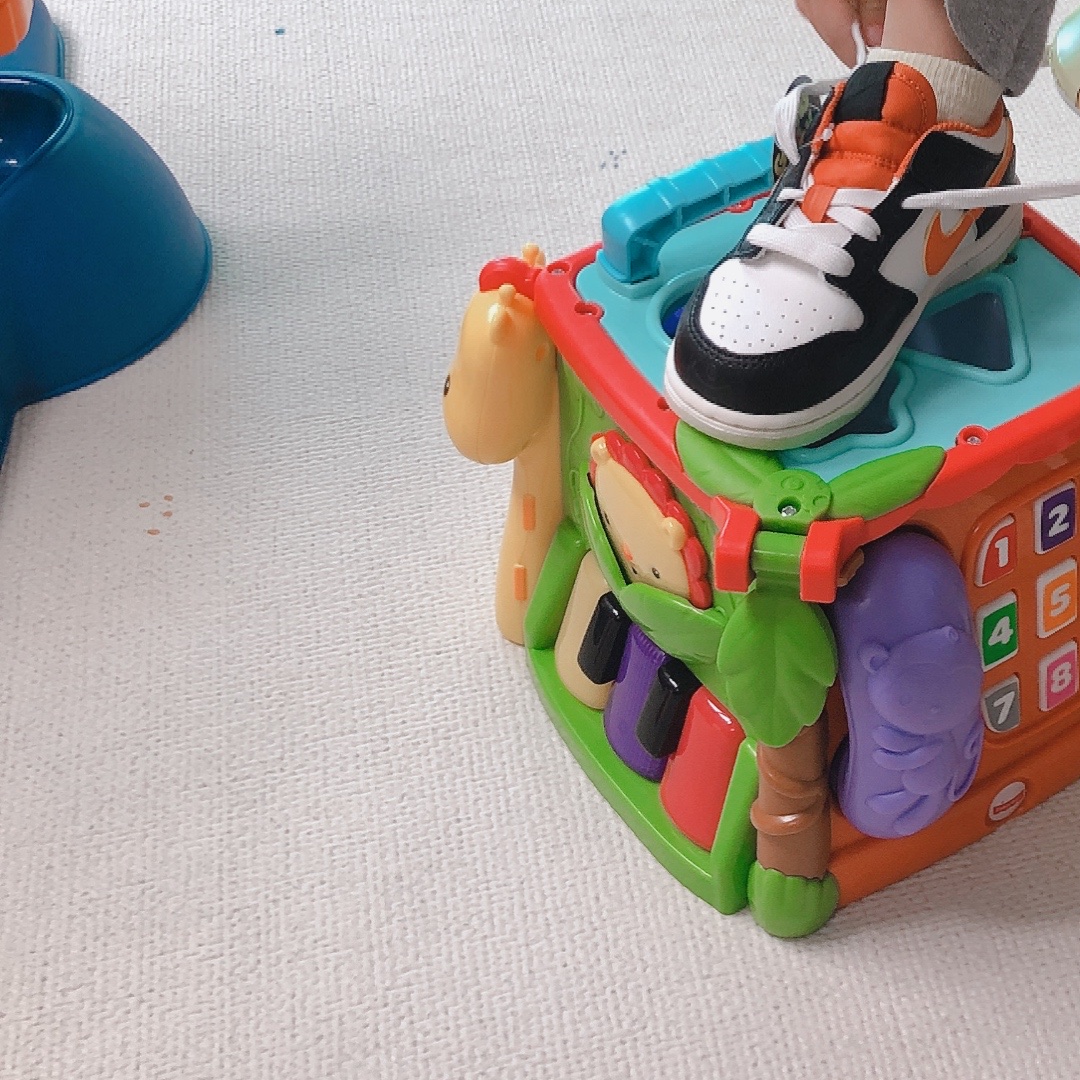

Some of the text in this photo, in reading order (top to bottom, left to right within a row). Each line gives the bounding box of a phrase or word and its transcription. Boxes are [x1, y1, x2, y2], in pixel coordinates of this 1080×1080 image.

[995, 536, 1009, 568] 1
[1048, 503, 1070, 537] 2
[988, 616, 1013, 647] 4
[1050, 582, 1071, 617] 5
[993, 691, 1015, 725] 7
[1050, 661, 1072, 694] 8
